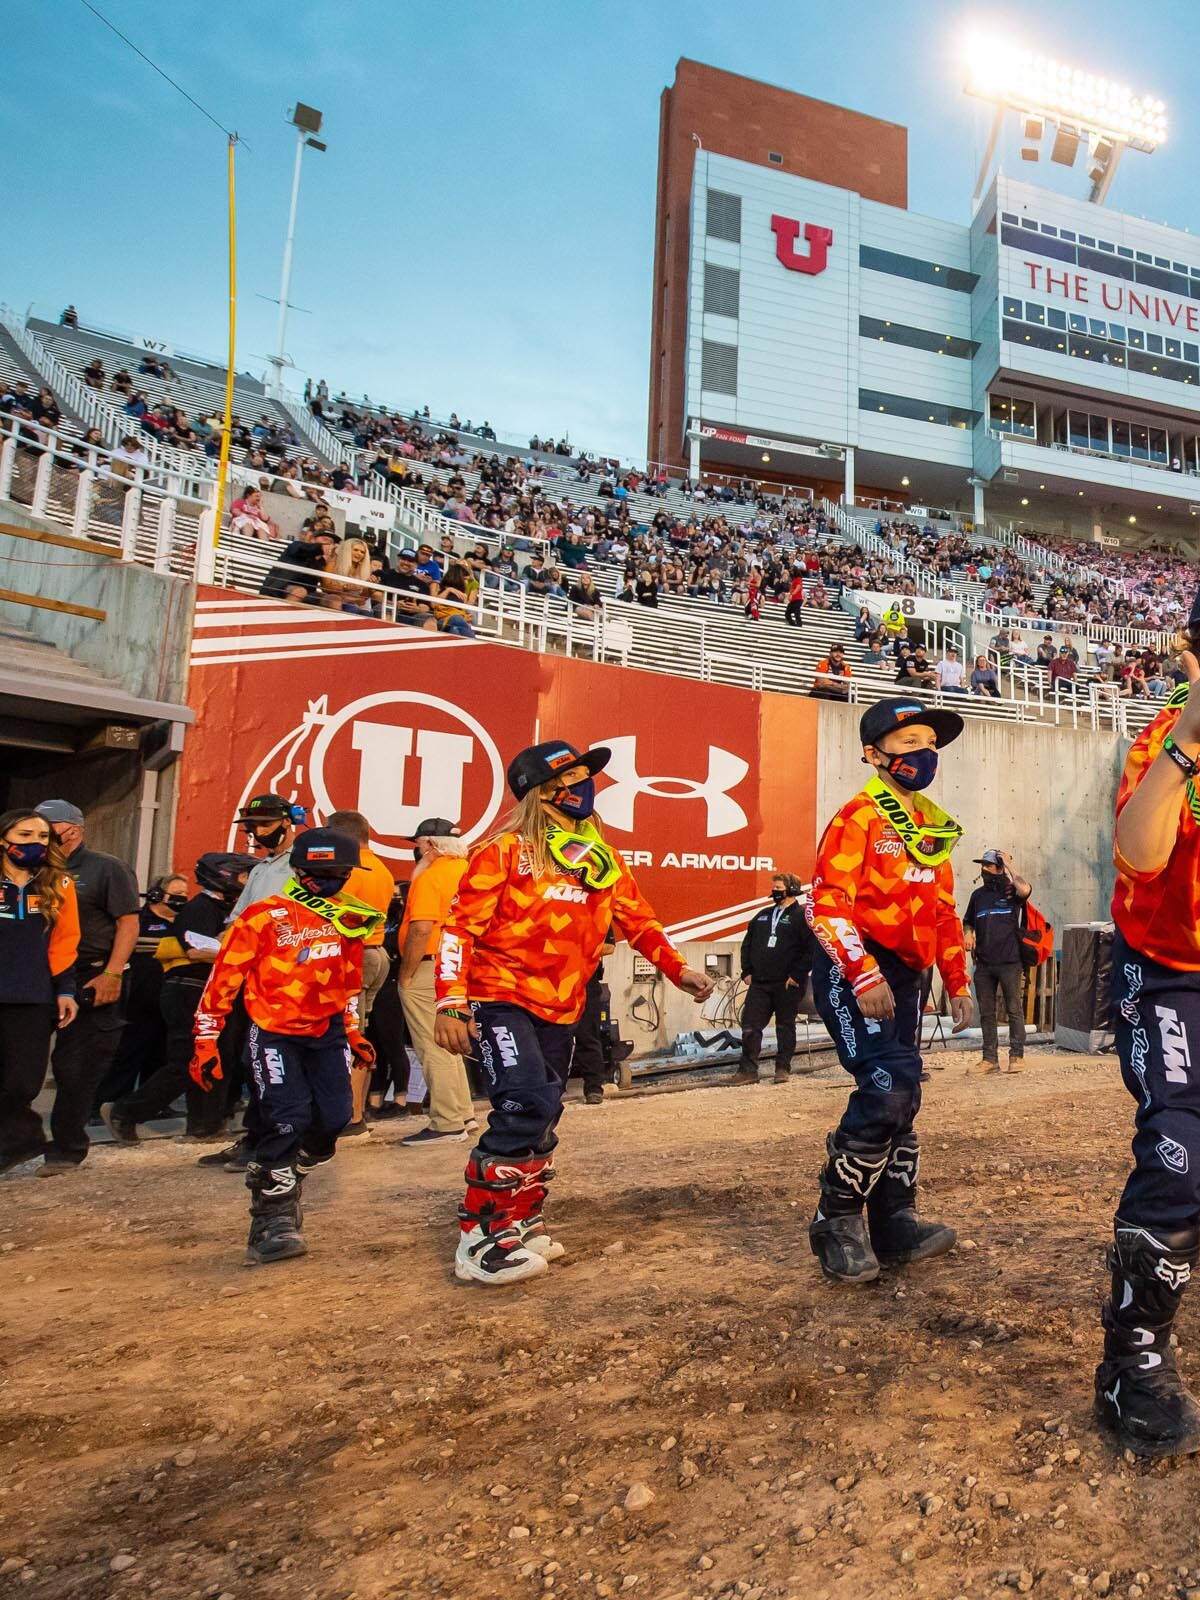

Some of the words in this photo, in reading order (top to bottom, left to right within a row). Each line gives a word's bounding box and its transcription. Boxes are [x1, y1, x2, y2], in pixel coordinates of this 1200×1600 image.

[770, 213, 833, 276] U
[1023, 261, 1089, 303] THE
[142, 338, 168, 352] W7
[901, 598, 916, 616] 8
[351, 720, 474, 837] U
[873, 789, 921, 842] 100%
[288, 886, 340, 919] 100%
[543, 883, 590, 905] KTM
[439, 932, 463, 981] KTM
[491, 1025, 520, 1068] KTM
[1154, 1004, 1192, 1084] KTM
[264, 1047, 286, 1085] KTM
